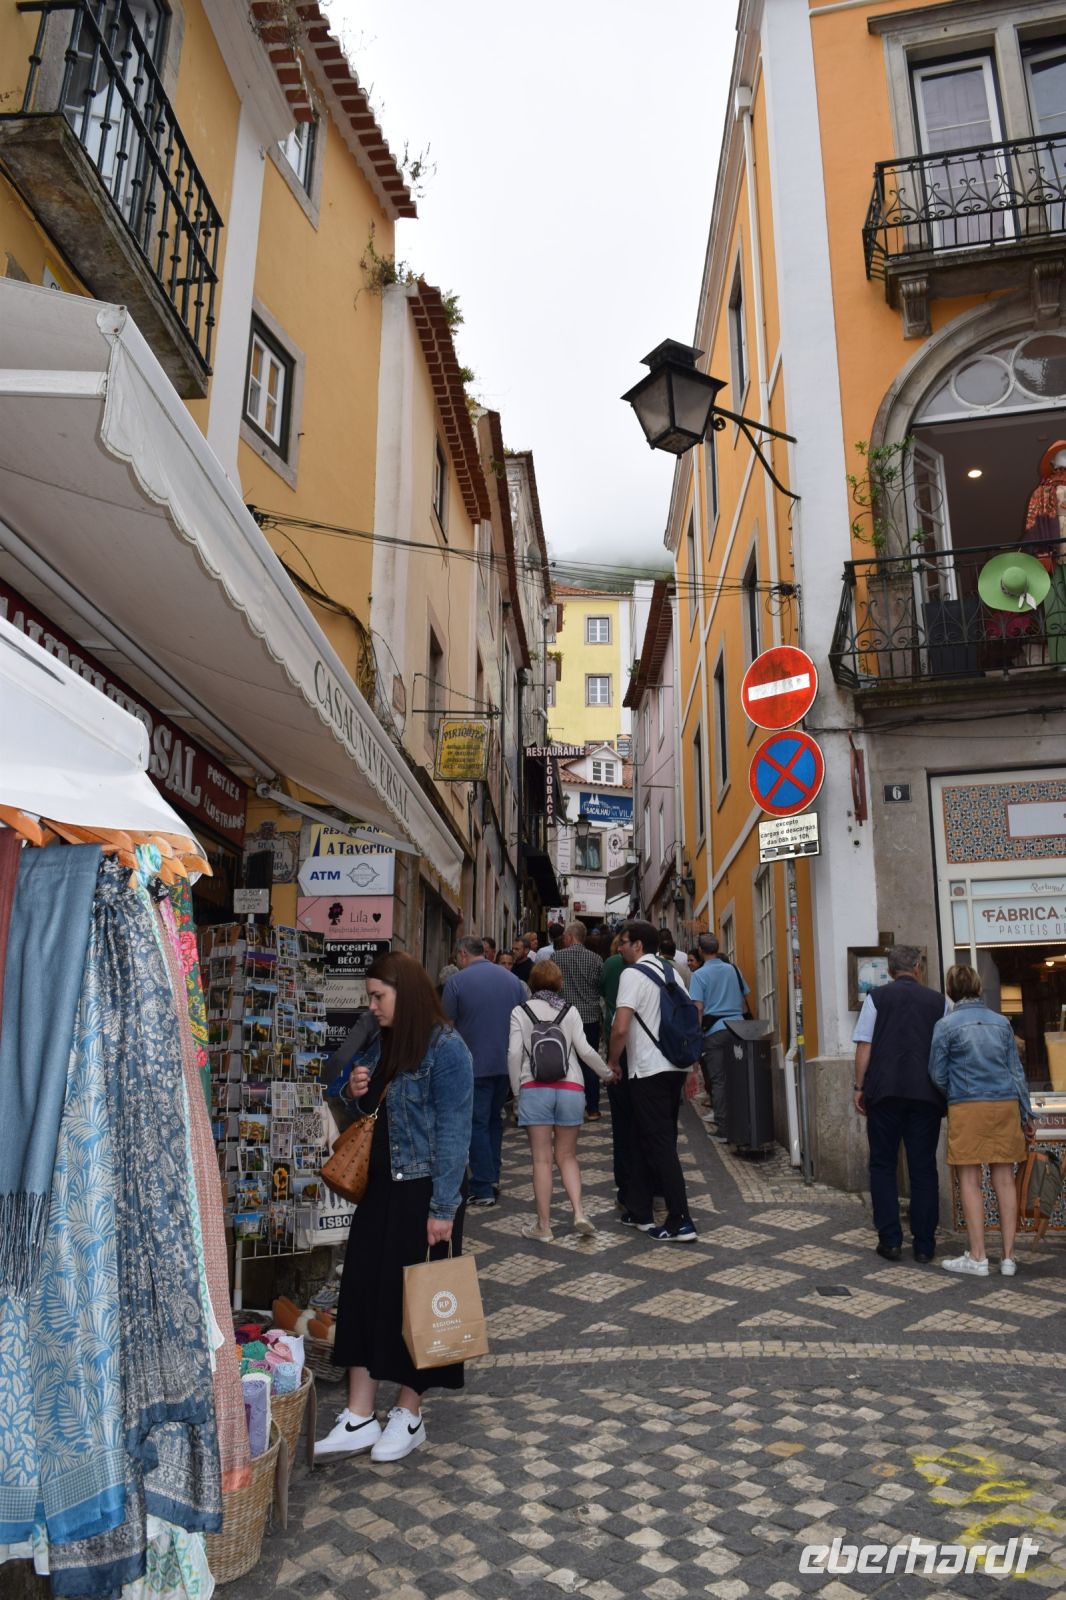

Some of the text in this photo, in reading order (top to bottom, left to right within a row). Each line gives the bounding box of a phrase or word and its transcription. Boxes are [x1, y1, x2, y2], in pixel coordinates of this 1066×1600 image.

[314, 660, 410, 823] CASA UNIVERSAL
[526, 746, 585, 757] RESTAURANTE
[892, 786, 902, 800] 6
[776, 819, 799, 828] excepto
[760, 830, 780, 839] cargas
[786, 824, 816, 834] descargas
[327, 841, 393, 855] A Taverna
[310, 871, 341, 881] ATM
[350, 910, 368, 923] Lila
[981, 905, 1060, 923] FÁBRICA
[337, 956, 361, 965] BECO
[439, 1301, 450, 1309] RP
[432, 1318, 462, 1329] REGIONAL
